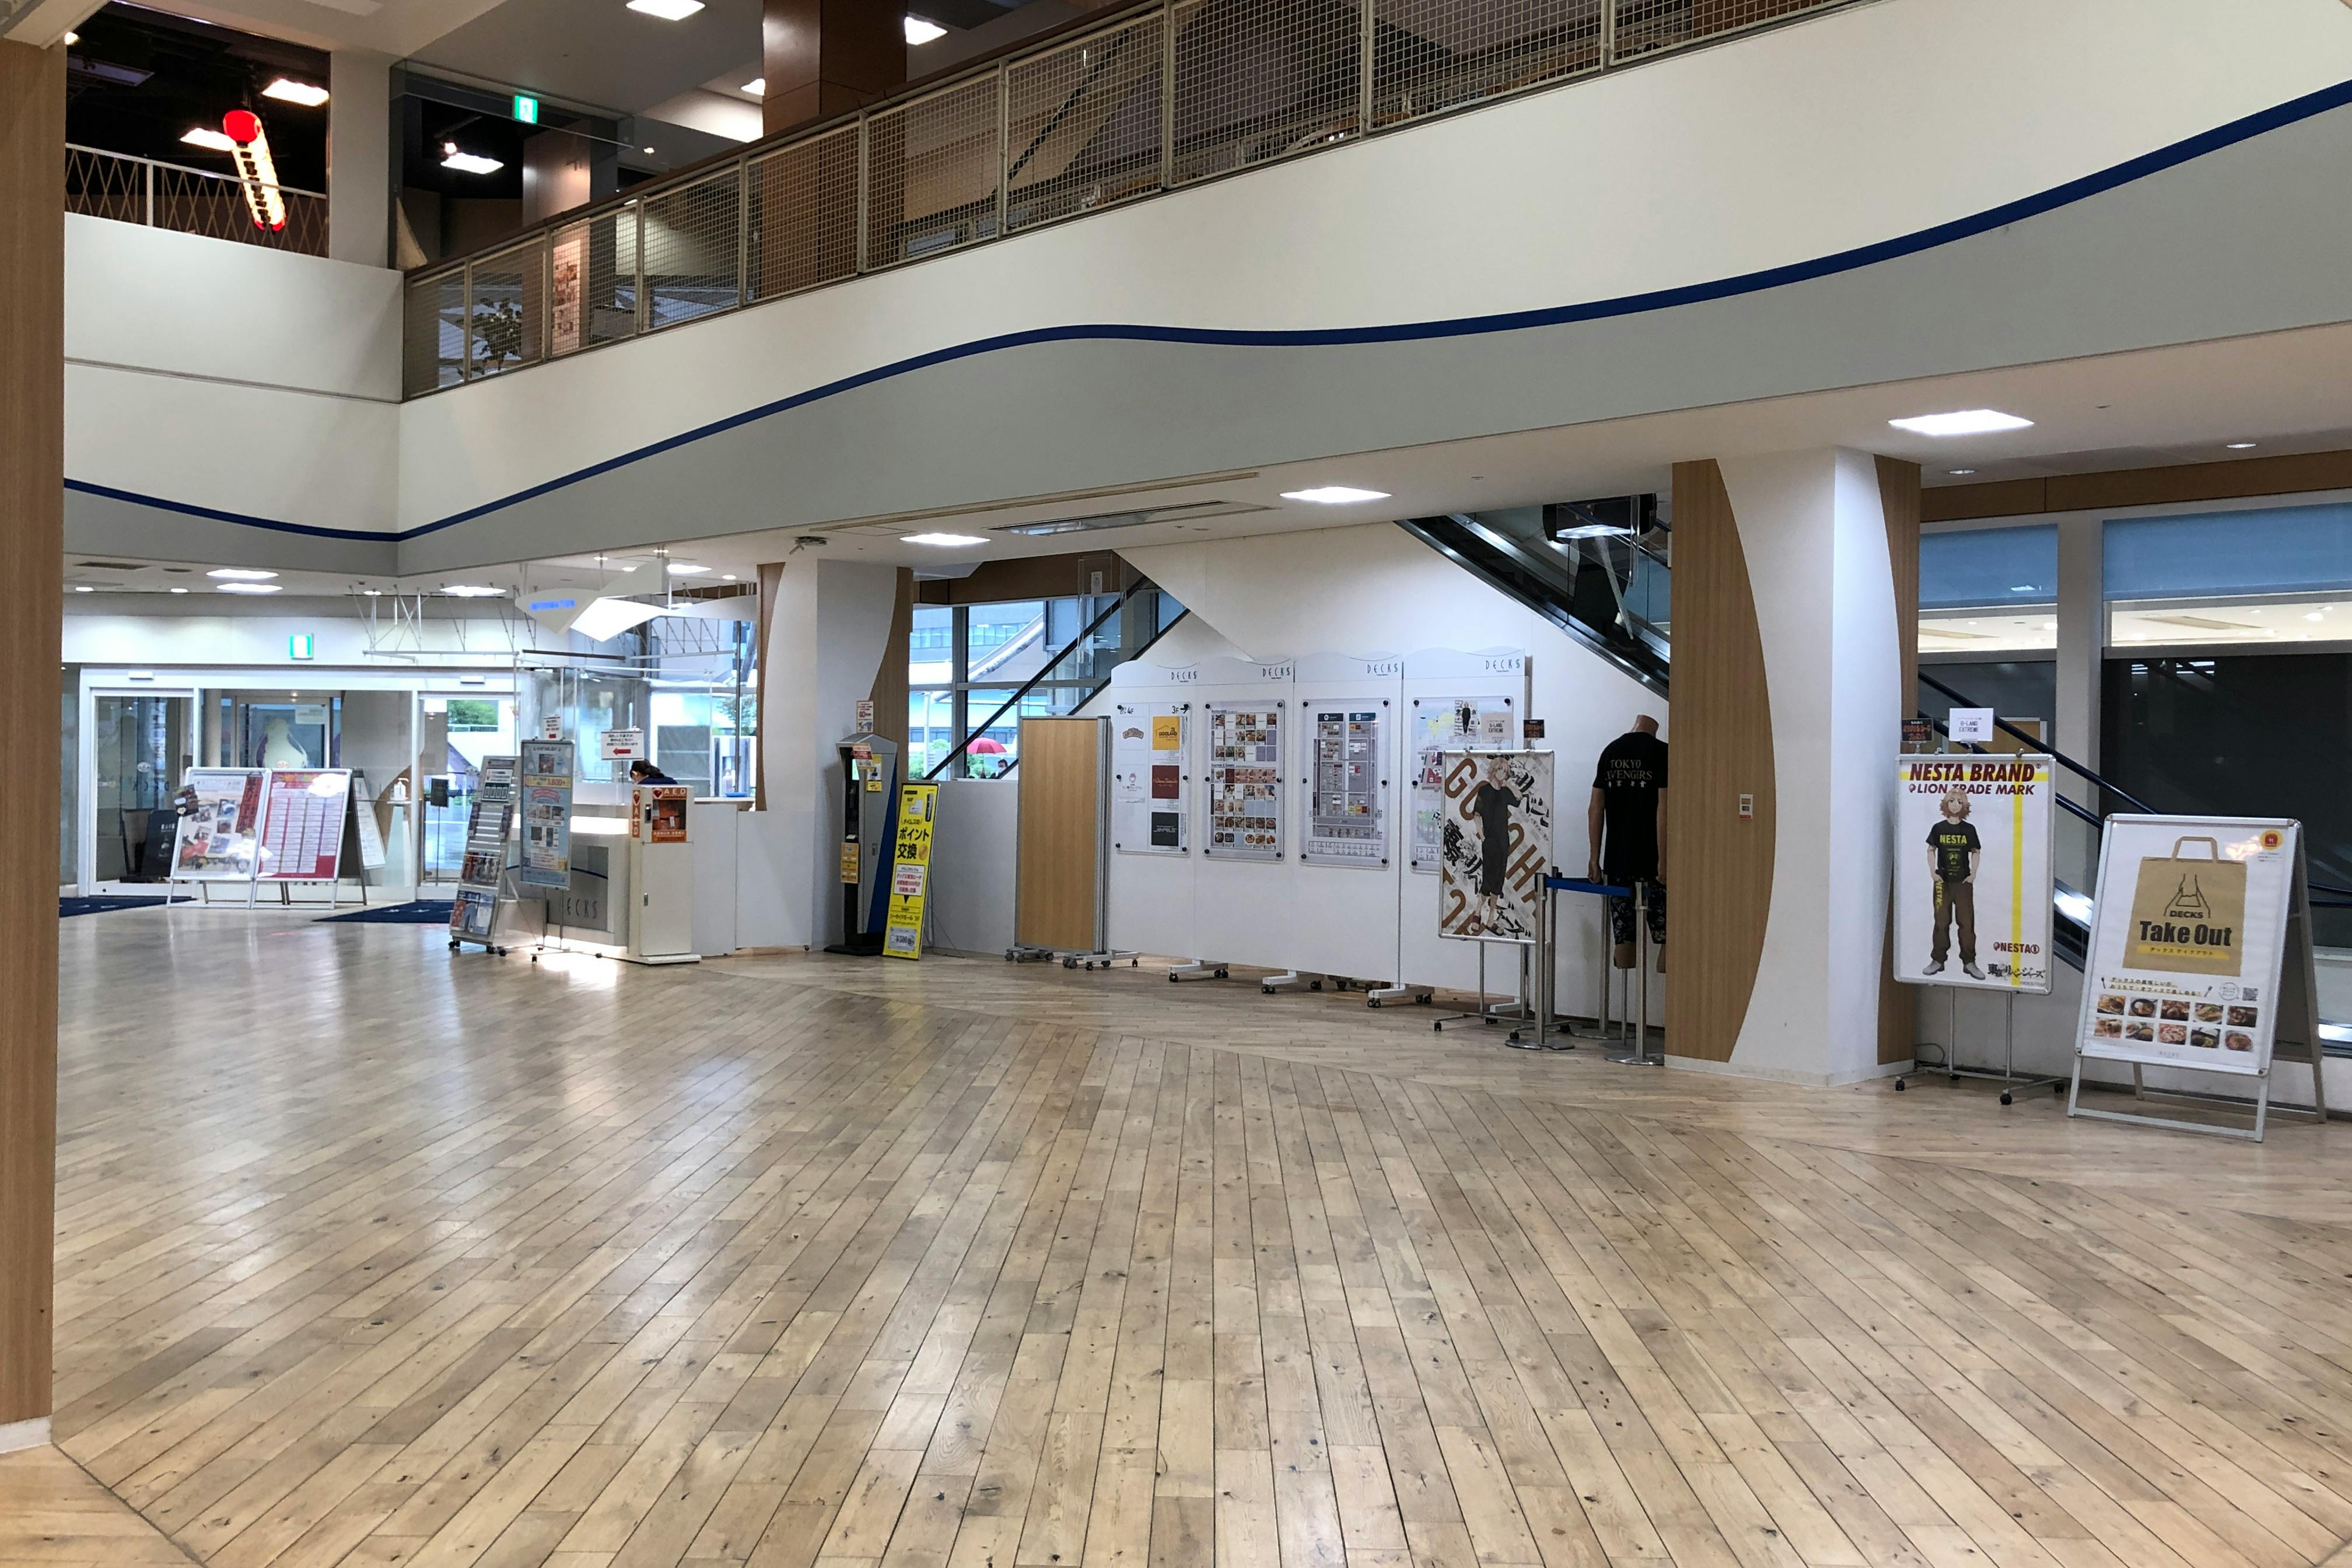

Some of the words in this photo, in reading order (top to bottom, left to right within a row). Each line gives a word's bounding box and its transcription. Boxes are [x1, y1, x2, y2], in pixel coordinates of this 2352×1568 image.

[1367, 663, 1398, 674] DECKS
[1486, 659, 1520, 670] DECKS
[1171, 671, 1197, 680] DECKS
[1262, 667, 1290, 677] DECKS
[1171, 705, 1179, 714] 3F
[1610, 759, 1642, 769] TOKYO
[1909, 763, 1964, 781] NESTA
[1969, 763, 2035, 782] BRAND
[1917, 783, 1948, 794] LION
[1995, 785, 2035, 795] MARK
[899, 827, 929, 841] ポイント
[1940, 834, 1967, 844] NESTA
[897, 842, 917, 859] 交換
[566, 897, 598, 919] ECKS
[2169, 910, 2203, 919] DECKS
[2139, 921, 2190, 944] Take
[2194, 924, 2233, 947] Out
[2000, 942, 2031, 954] NESTA
